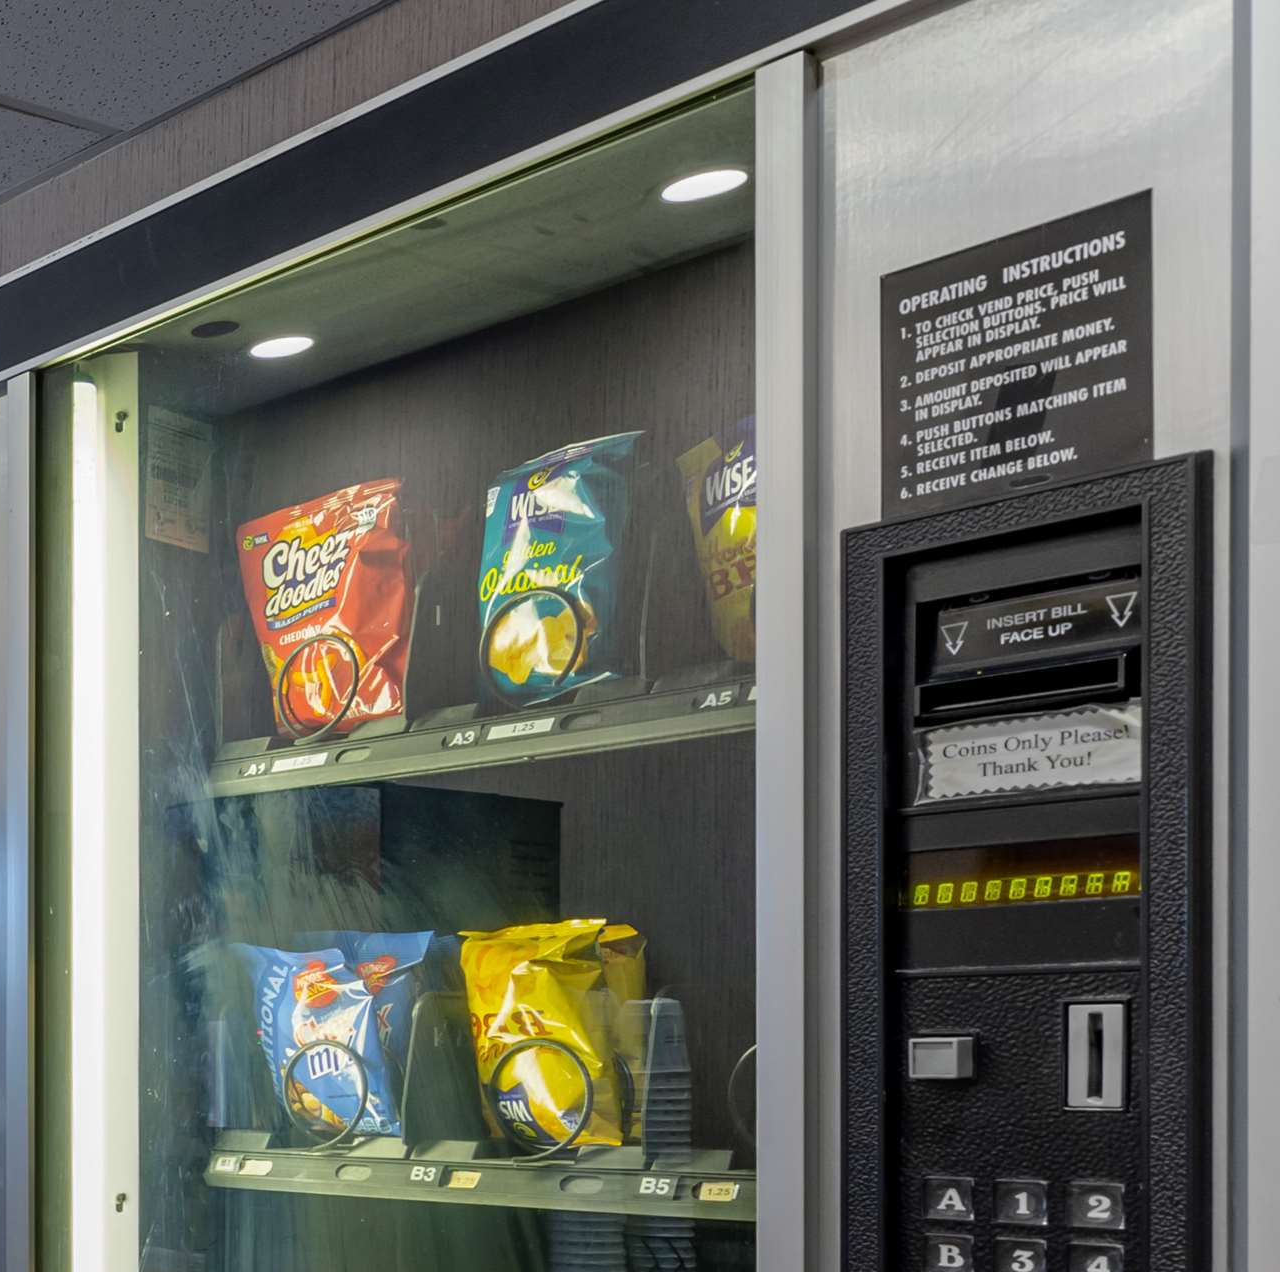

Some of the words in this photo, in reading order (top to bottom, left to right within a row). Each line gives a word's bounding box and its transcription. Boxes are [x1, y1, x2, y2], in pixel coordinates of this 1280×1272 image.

[899, 274, 988, 315] OPERATING
[1003, 230, 1126, 284] INSTRUCTIONS
[900, 327, 912, 340] 1.
[915, 320, 932, 335] TO
[935, 306, 974, 329] CHECK
[978, 296, 1013, 316] VEND
[1017, 282, 1058, 306] PRICE,
[1062, 268, 1099, 292] PUSH
[916, 320, 979, 349] SELECTION
[983, 300, 1047, 330] BUTTONS.
[1050, 286, 1089, 310] PRICE
[1092, 276, 1127, 297] WILL
[900, 375, 912, 389] 2.
[915, 358, 966, 384] DEPOSIT
[969, 332, 1058, 370] APPROPRIATE
[1062, 317, 1115, 343] MONEY.
[915, 338, 963, 363] APPEAR
[967, 332, 982, 348] IN
[986, 316, 1042, 343] DISPLAY.
[900, 399, 912, 412] 3.
[914, 382, 968, 408] AMOUNT
[970, 364, 1037, 394] DEPOSITED
[1040, 354, 1073, 375] WILL
[1075, 339, 1127, 366] APPEAR
[900, 433, 913, 447] 4.
[916, 423, 950, 443] PUSH
[953, 407, 1012, 434] BUTTONS
[1016, 387, 1089, 418] MATCHING
[1093, 377, 1127, 398] ITEM
[915, 407, 929, 423] IN
[931, 393, 983, 418] DISPLAY.
[900, 465, 913, 479] 5.
[916, 451, 967, 475] RECEIVE
[970, 442, 1001, 462] ITEM
[1006, 429, 1056, 453] BELOW.
[917, 431, 979, 457] SELECTED.
[900, 487, 913, 499] 6.
[916, 473, 967, 496] RECEIVE
[970, 459, 1024, 483] CHANGE
[1027, 446, 1079, 470] BELOW.
[512, 490, 555, 522] WIS
[263, 530, 351, 590] Cheez
[264, 560, 345, 618] doodles
[302, 599, 330, 617] PUFFS
[986, 608, 1047, 631] INSERT
[1051, 602, 1089, 620] BILL
[1000, 627, 1045, 645] FACE
[1048, 622, 1073, 637] UP
[698, 690, 733, 710] A5
[448, 731, 474, 747] A3
[942, 739, 998, 760] Coins
[1003, 733, 1053, 754] Only
[1059, 724, 1131, 747] Please!
[244, 762, 266, 777] A1
[977, 757, 1040, 778] Thank
[1045, 751, 1093, 771] You!
[499, 1100, 533, 1123] WIS
[410, 1165, 436, 1182] B3
[639, 1176, 671, 1195] B5
[707, 1187, 731, 1197] 1.25
[937, 1188, 966, 1212] A
[1014, 1193, 1032, 1215] 1
[1087, 1195, 1112, 1219] 2
[938, 1243, 964, 1269] B
